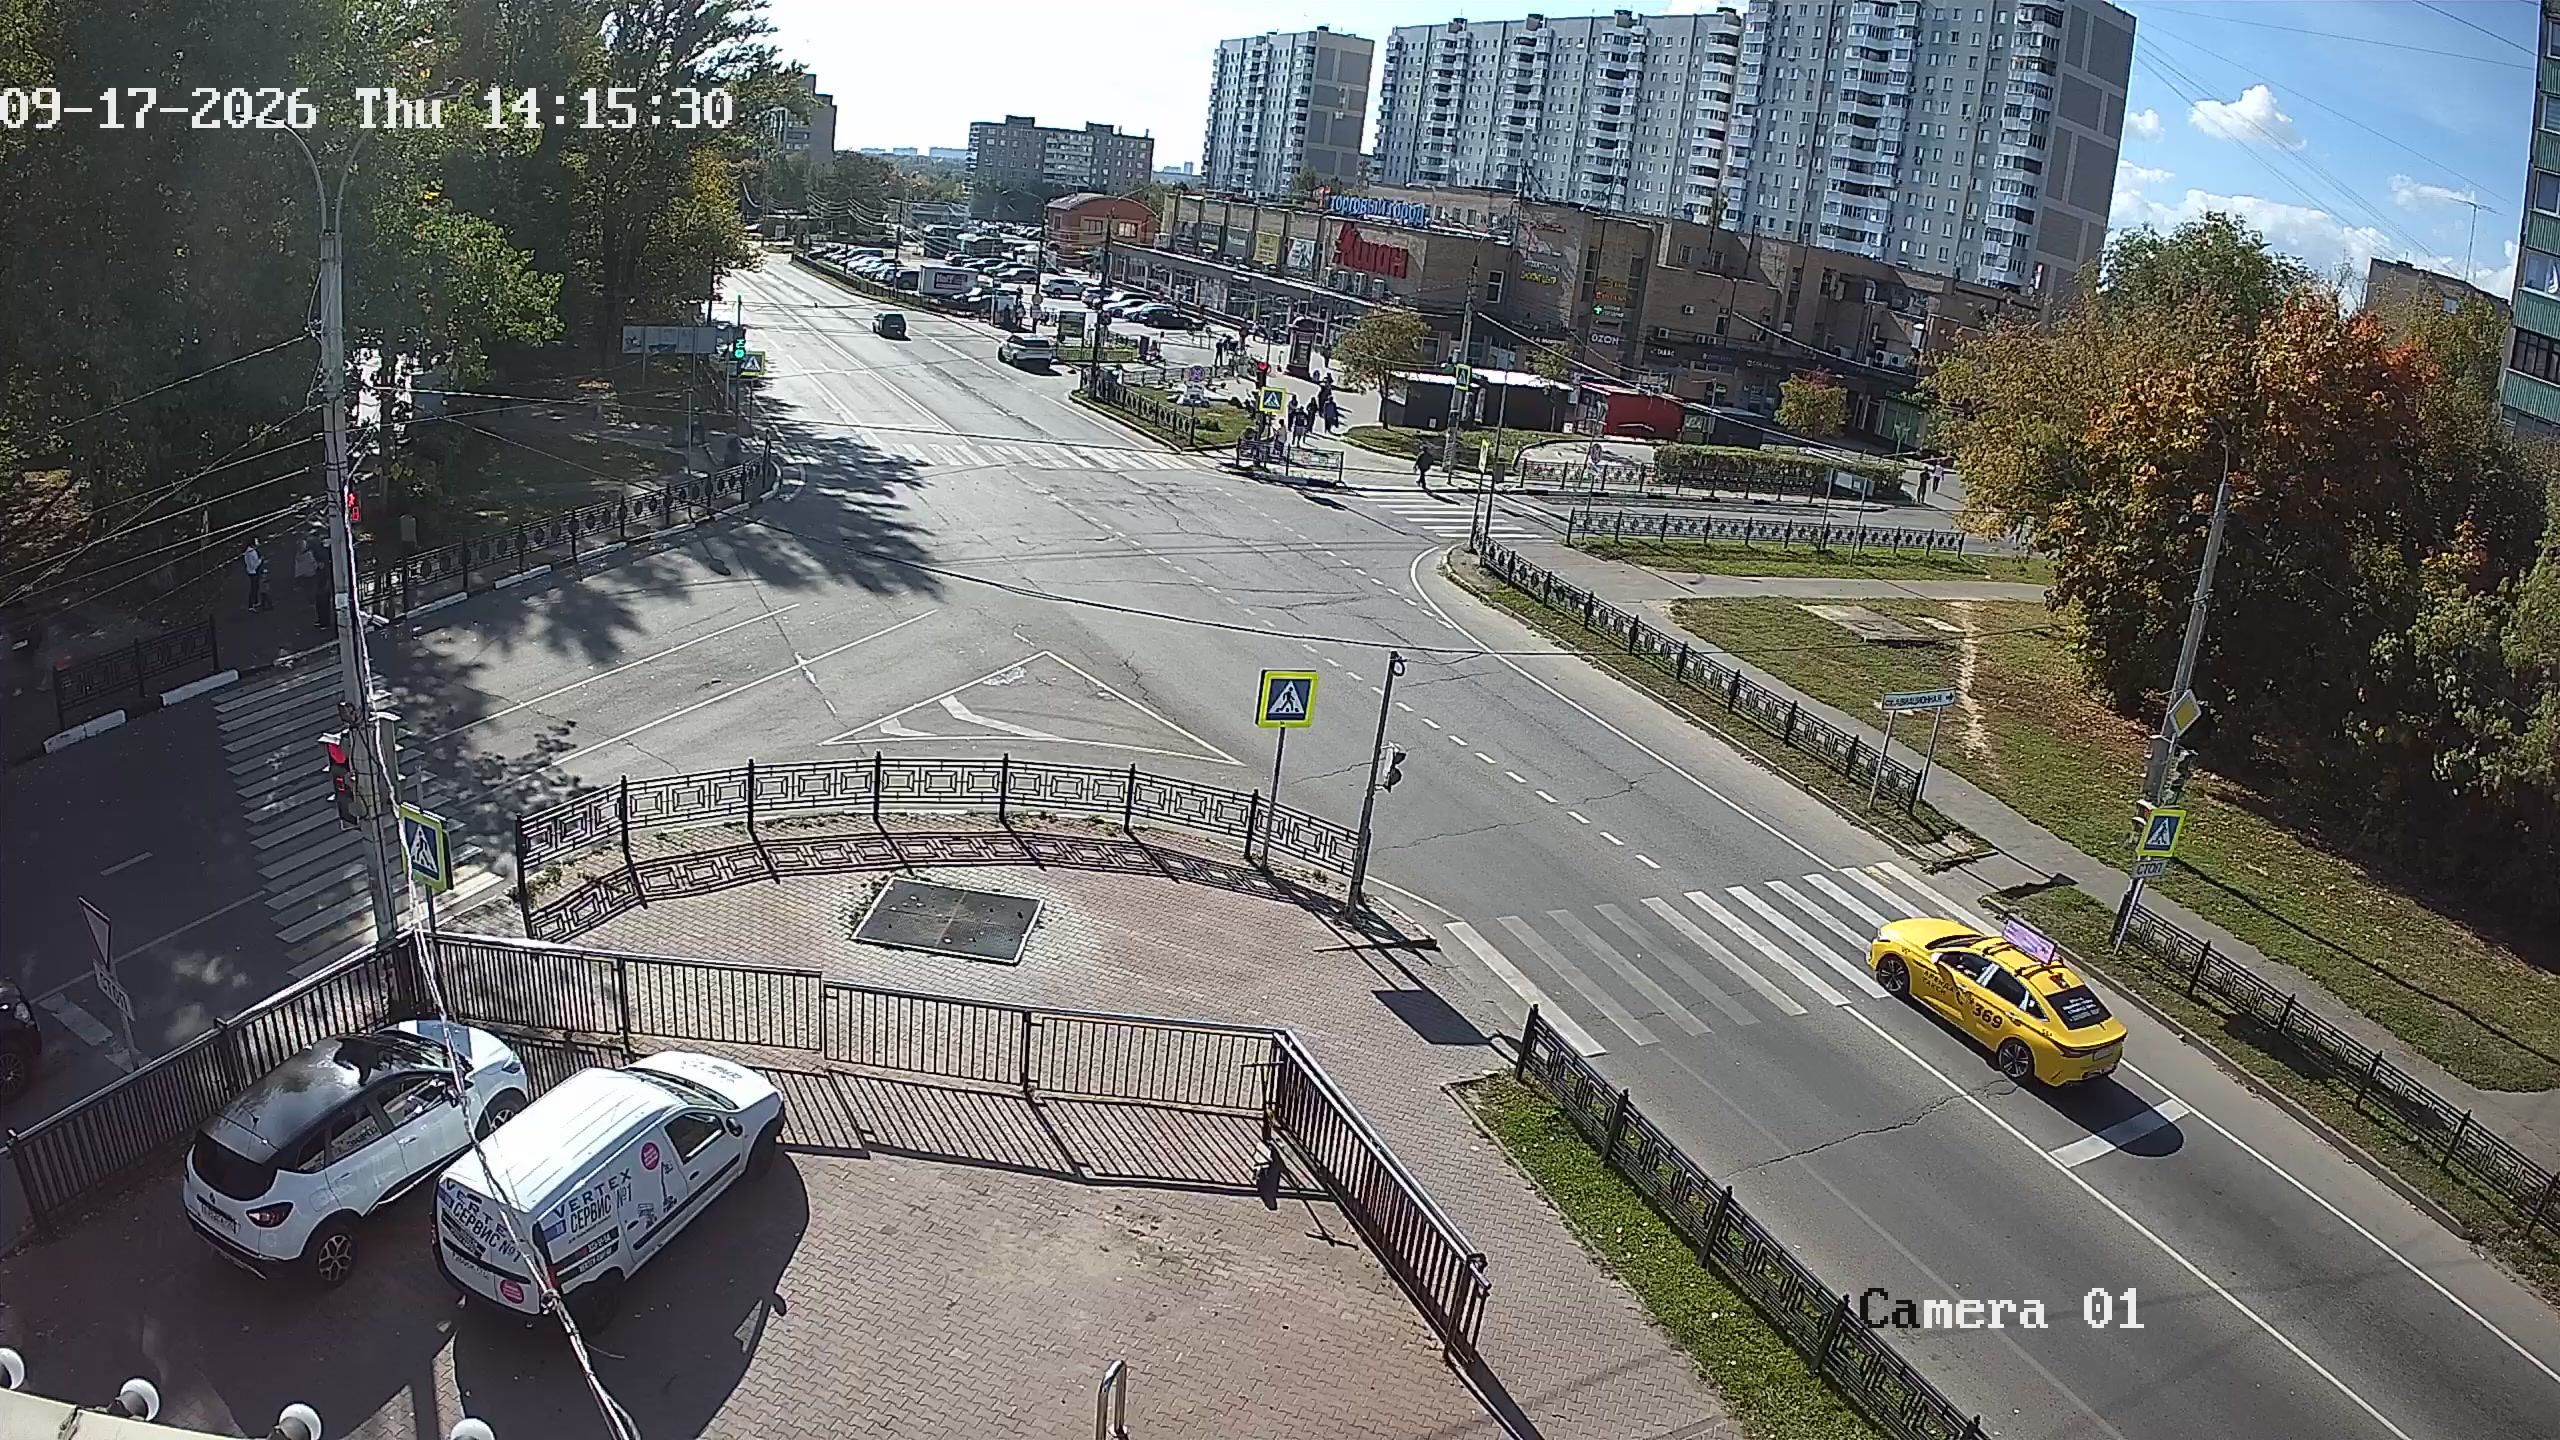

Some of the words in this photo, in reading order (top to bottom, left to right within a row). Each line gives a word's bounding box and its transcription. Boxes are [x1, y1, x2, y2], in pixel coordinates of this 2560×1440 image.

[1591, 333, 1619, 345] OZON
[2137, 862, 2163, 875] СТОП
[446, 1178, 525, 1244] VERTE
[553, 1168, 632, 1219] VERTEX
[570, 1193, 612, 1234] СЕРВИС
[616, 1183, 632, 1209] №1
[453, 1201, 501, 1248] СЕРВИС
[499, 1240, 521, 1263] №1
